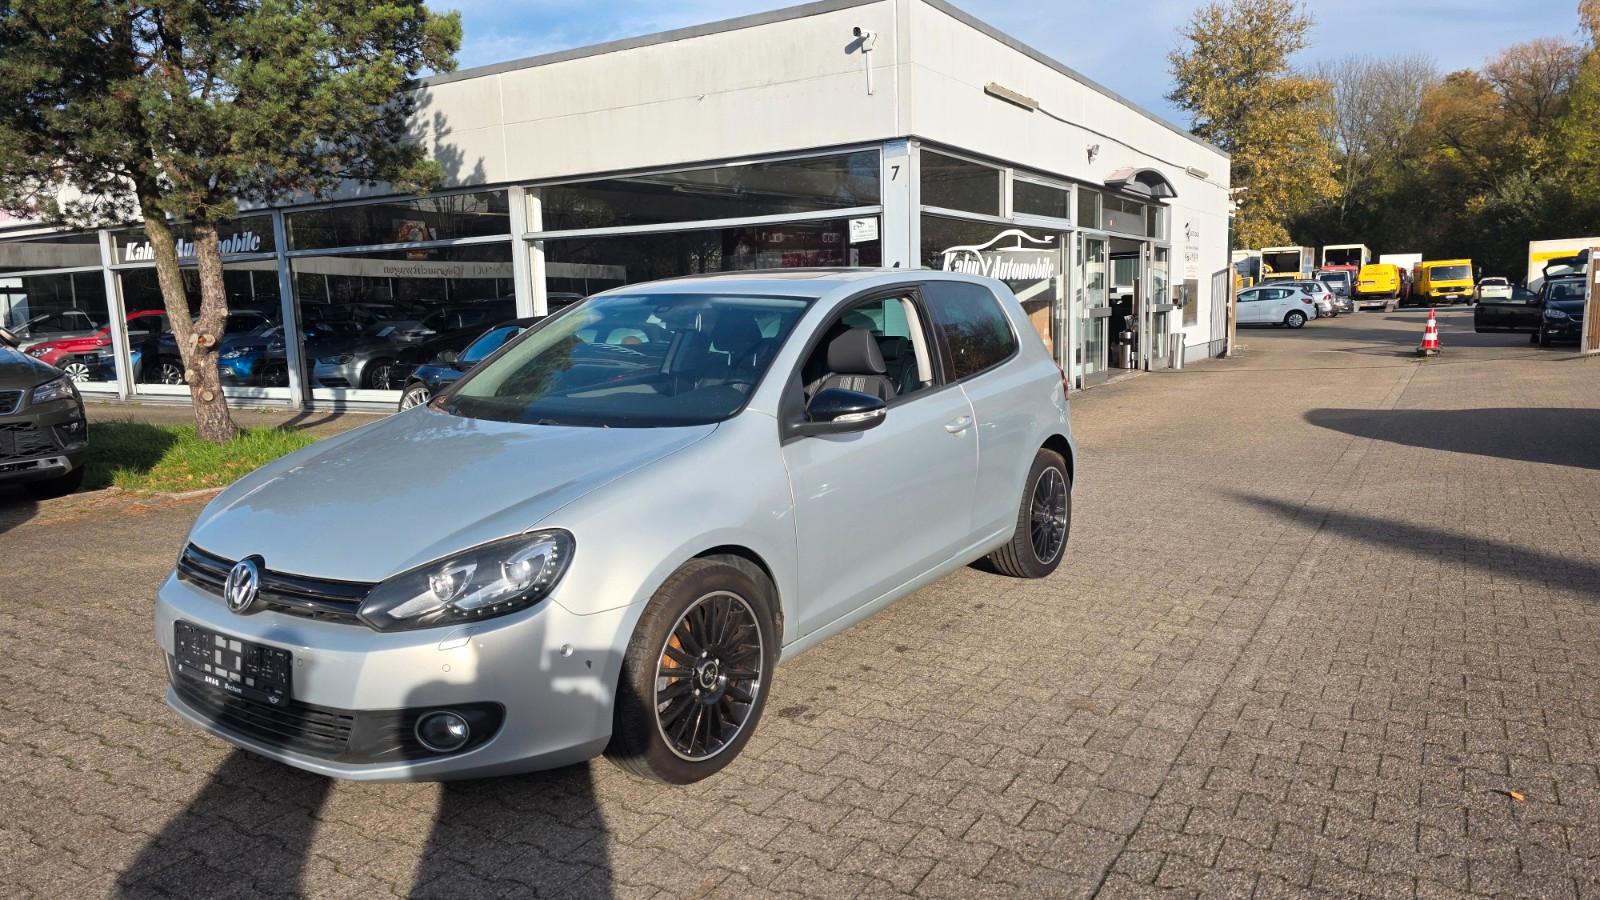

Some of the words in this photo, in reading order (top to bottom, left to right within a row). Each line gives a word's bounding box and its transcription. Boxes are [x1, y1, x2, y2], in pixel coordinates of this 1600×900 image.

[891, 165, 901, 181] 7
[125, 241, 156, 261] Kah
[175, 231, 261, 258] Auobile
[942, 252, 981, 276] Kahn
[990, 255, 1055, 280] Automobile
